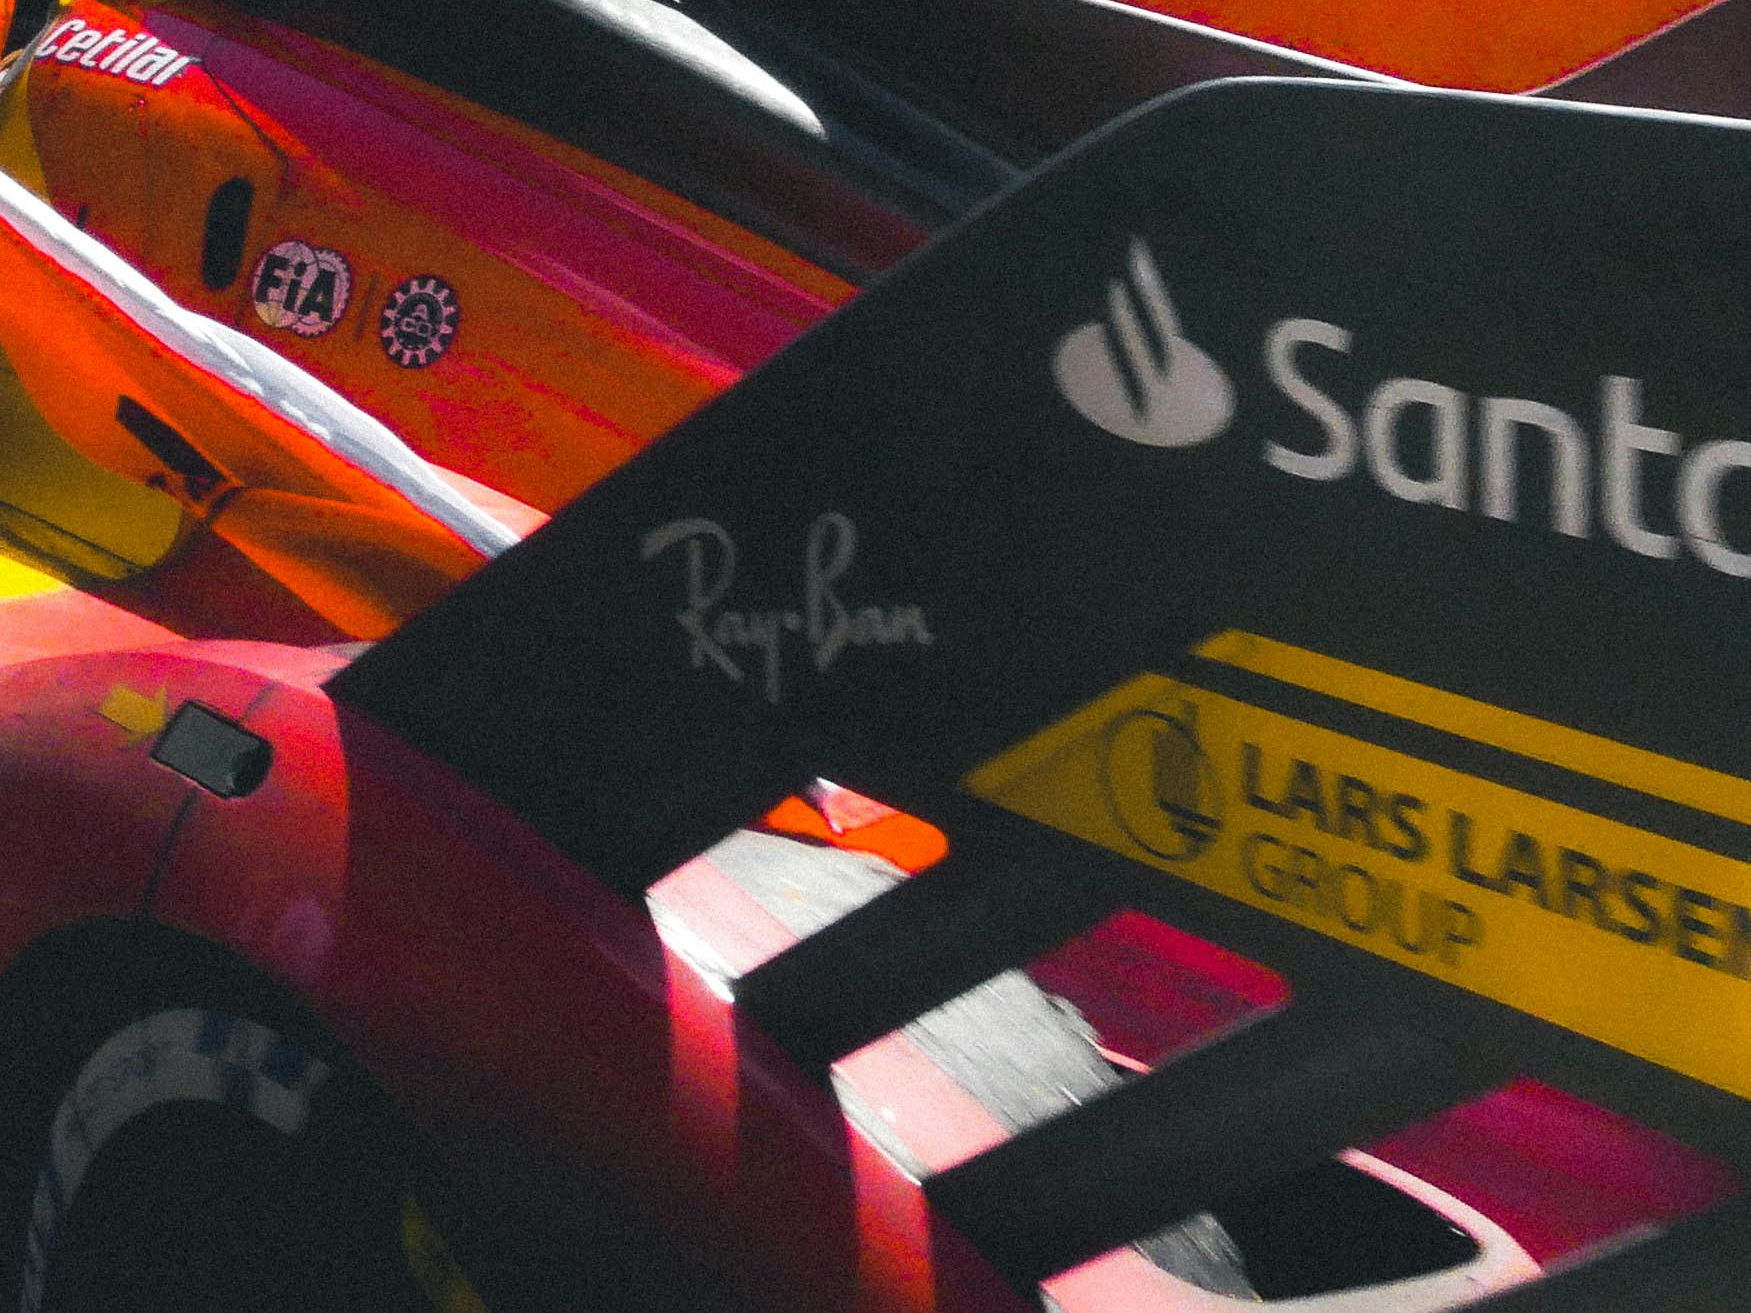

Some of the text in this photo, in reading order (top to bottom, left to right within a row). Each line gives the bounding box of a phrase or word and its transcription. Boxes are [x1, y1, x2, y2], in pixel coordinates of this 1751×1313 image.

[34, 18, 198, 87] Cetilar
[1243, 741, 1432, 864] LARS
[1243, 832, 1486, 971] GROUP
